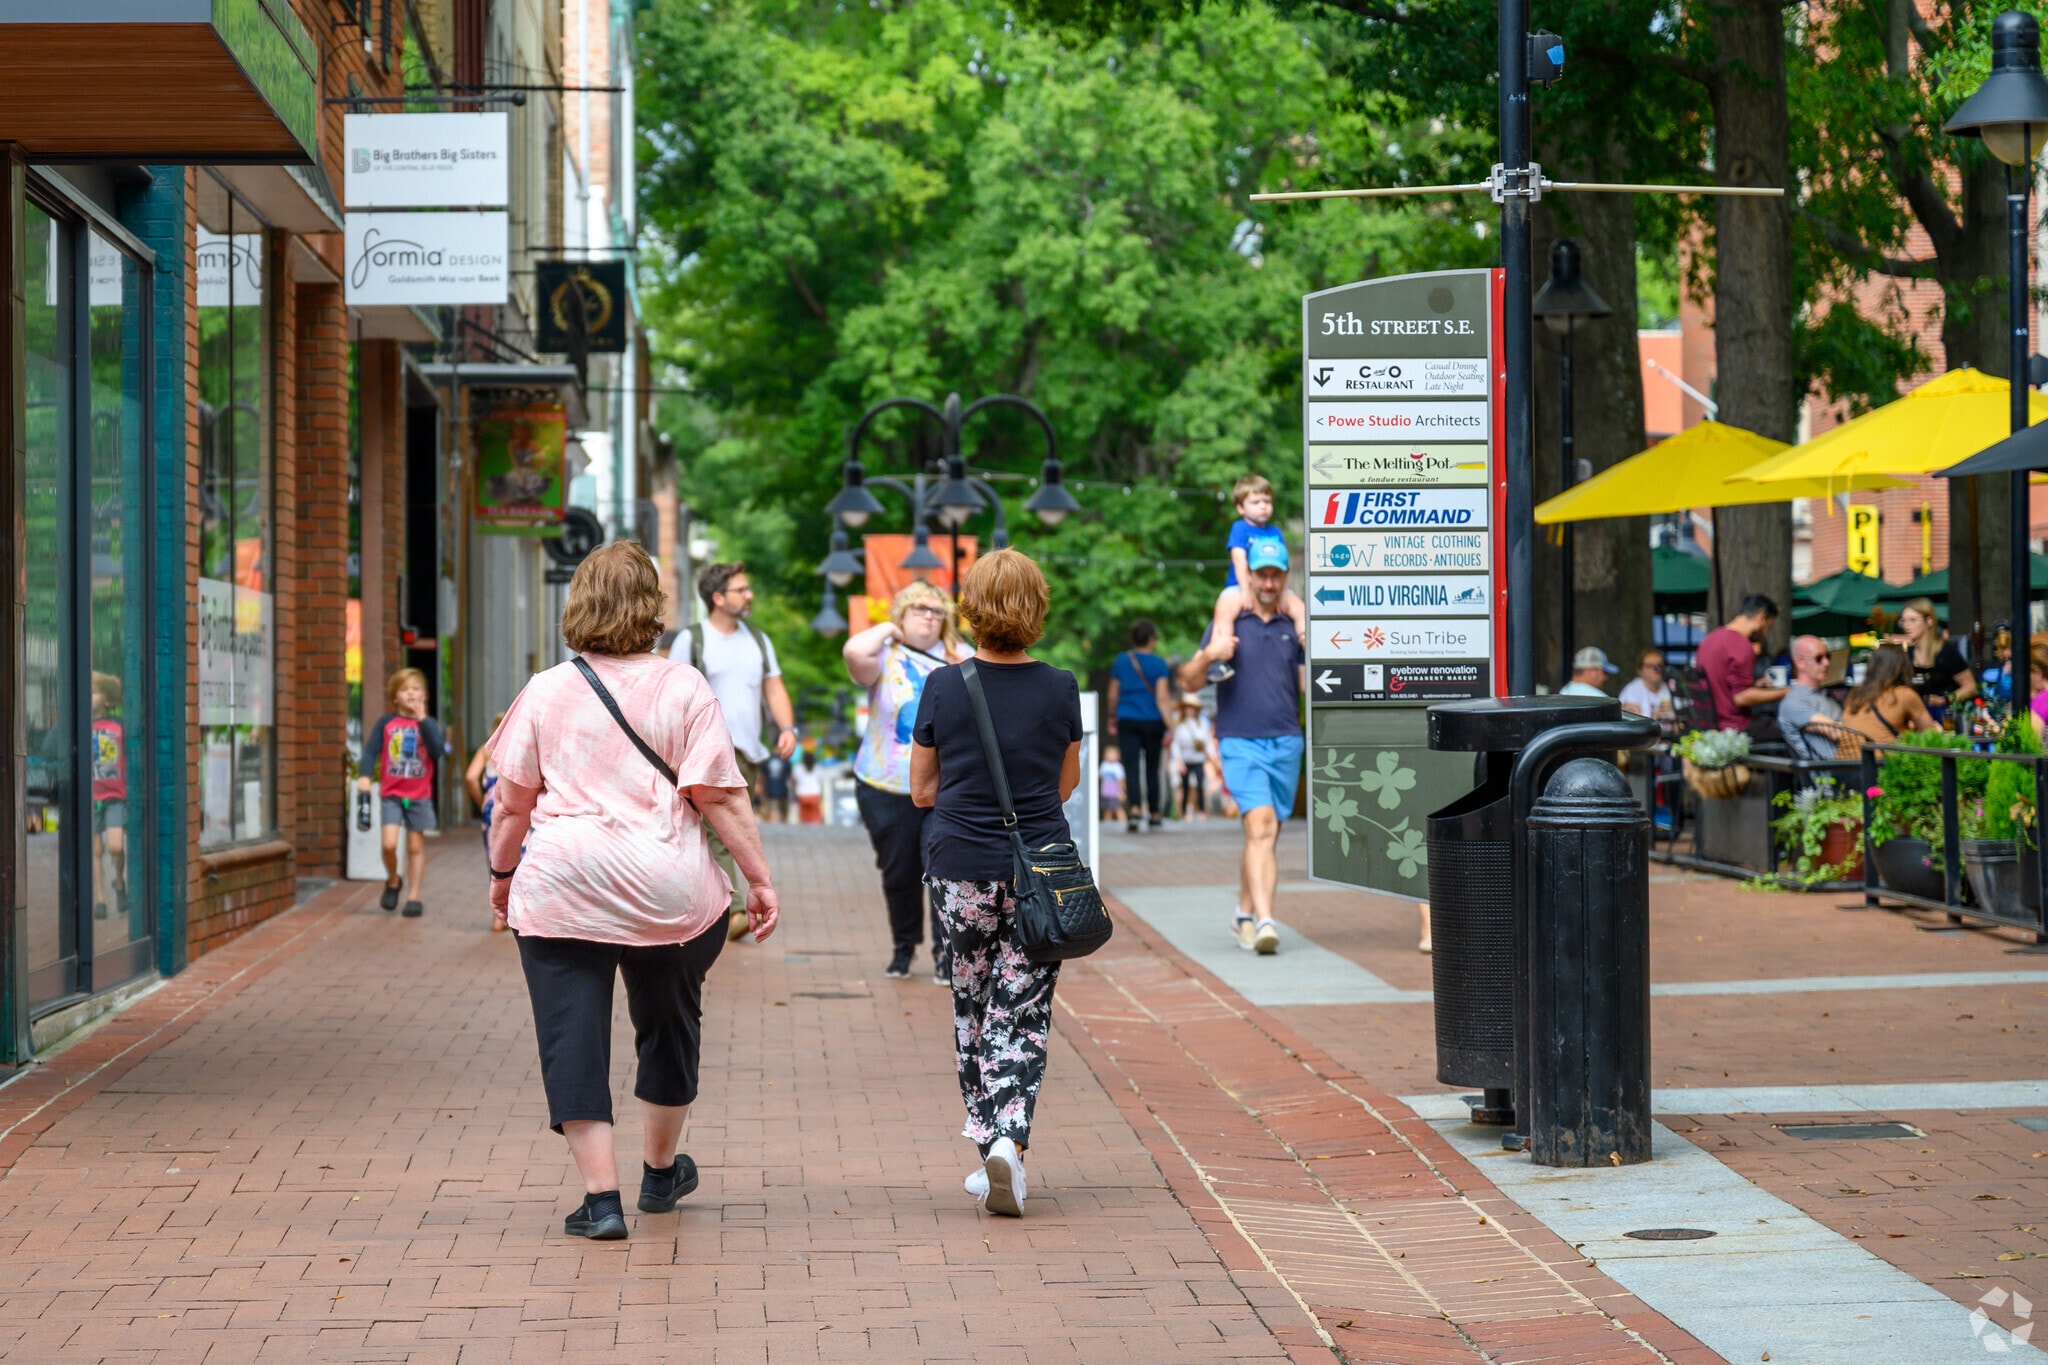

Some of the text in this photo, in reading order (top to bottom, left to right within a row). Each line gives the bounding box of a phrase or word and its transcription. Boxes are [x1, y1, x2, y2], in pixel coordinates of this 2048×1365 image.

[373, 149, 390, 164] Big
[392, 149, 438, 160] Brothers
[440, 149, 458, 163] Big
[448, 254, 502, 266] DESIGN
[388, 275, 436, 283] Goldsmith
[439, 275, 456, 283] Mia
[1321, 312, 1475, 335] 5th STREET S.E.
[1359, 366, 1372, 378] C
[1388, 366, 1402, 378] O
[1424, 362, 1478, 372] Casual Dining
[1424, 372, 1485, 382] Outdoor Seating
[1346, 380, 1414, 390] RESTAURANT
[1424, 382, 1464, 393] Late Night
[1328, 415, 1481, 426] Powe Studio Architects
[1344, 458, 1370, 470] The
[1373, 458, 1424, 473] Melting
[1368, 476, 1395, 484] fondue
[1364, 492, 1420, 507] FIRST
[1360, 510, 1471, 524] COMMAND
[1384, 535, 1481, 548] VINTAGE CLOTHING
[1384, 553, 1481, 568] RECORDS ANTIQUES
[1349, 585, 1448, 606] WILD VIRGINIA
[1390, 632, 1467, 644] Sun Tribe
[1390, 665, 1477, 676] eyebrow renovation
[1389, 676, 1406, 692] &
